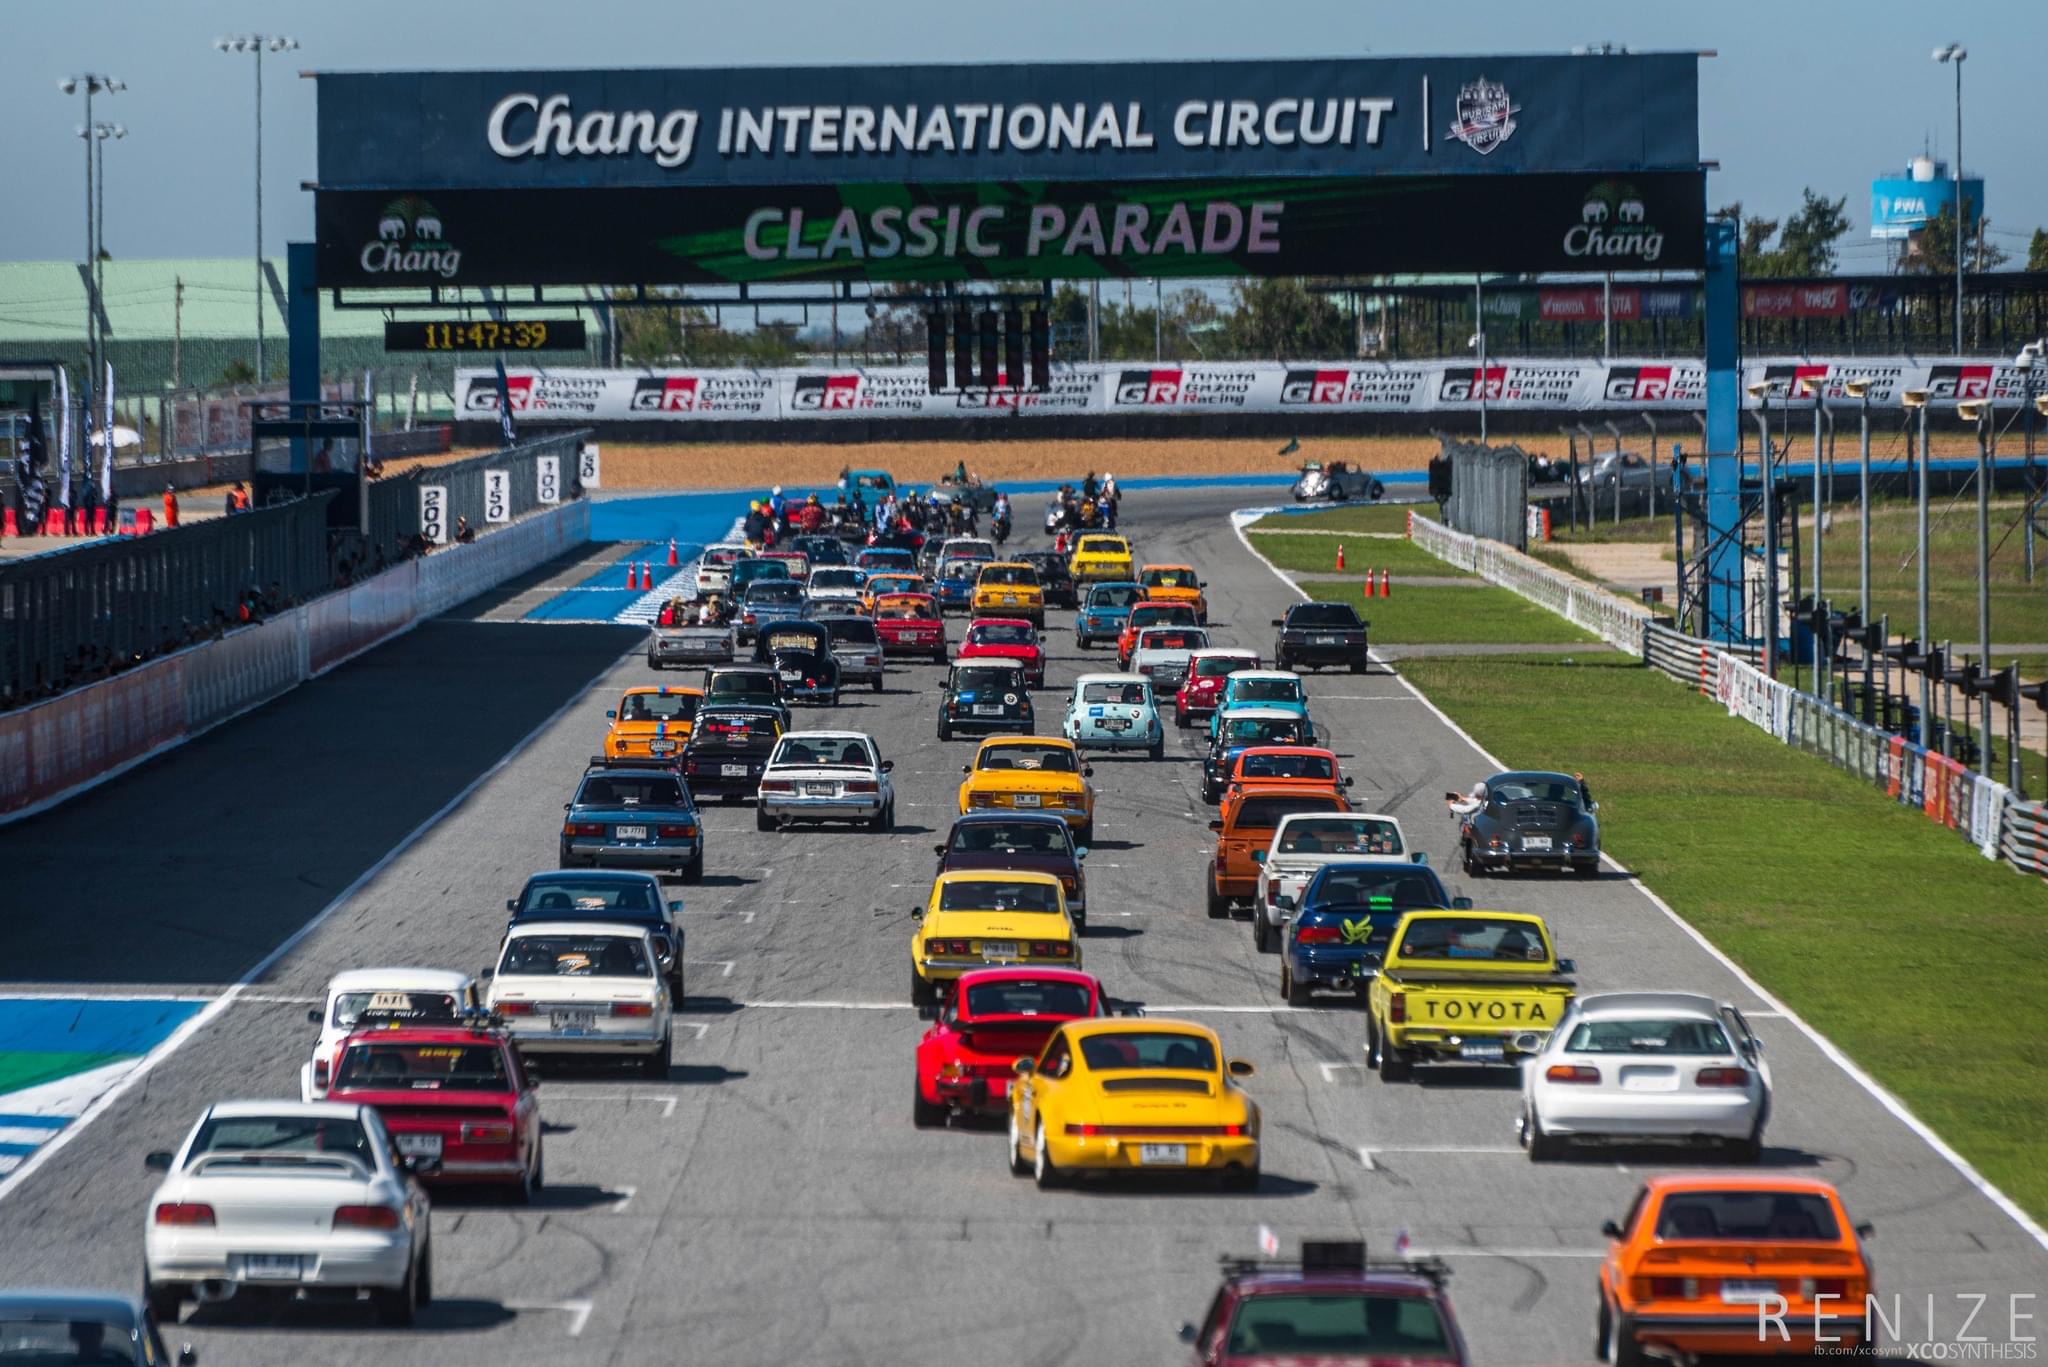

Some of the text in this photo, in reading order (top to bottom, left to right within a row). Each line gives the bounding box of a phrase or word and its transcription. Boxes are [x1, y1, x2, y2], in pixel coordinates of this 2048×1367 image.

[487, 93, 1395, 168] Chang INTERNATIONAL CIRCUIT
[1894, 197, 1926, 214] PWA
[742, 201, 1285, 261] CLASSIC PARADE
[1563, 224, 1664, 261] Chang
[360, 240, 462, 278] Chang
[425, 323, 547, 349] 11:47:39
[1190, 372, 1256, 383] TOYOTA
[1355, 371, 1422, 382] TOYOTA
[1440, 370, 1506, 400] GR
[1509, 379, 1573, 389] GAZOO
[1513, 367, 1580, 378] TOYOTA
[1604, 370, 1671, 400] GR
[1834, 367, 1902, 377] TOYOTA
[1926, 368, 1992, 399] GR
[630, 380, 698, 411] GR
[792, 379, 859, 410] GR
[1115, 373, 1182, 404] GR
[1183, 393, 1245, 406] Racing
[1280, 373, 1348, 404] GR
[1349, 392, 1411, 405] Racing
[1507, 390, 1569, 401] Racing
[533, 400, 596, 412] Racing
[699, 401, 762, 413] Racing
[860, 399, 923, 410] Racing
[541, 461, 555, 499] 100
[489, 474, 503, 519] 150
[424, 490, 440, 539] 200
[377, 995, 403, 1005] TAXI
[1426, 1001, 1546, 1020] TOYOTA
